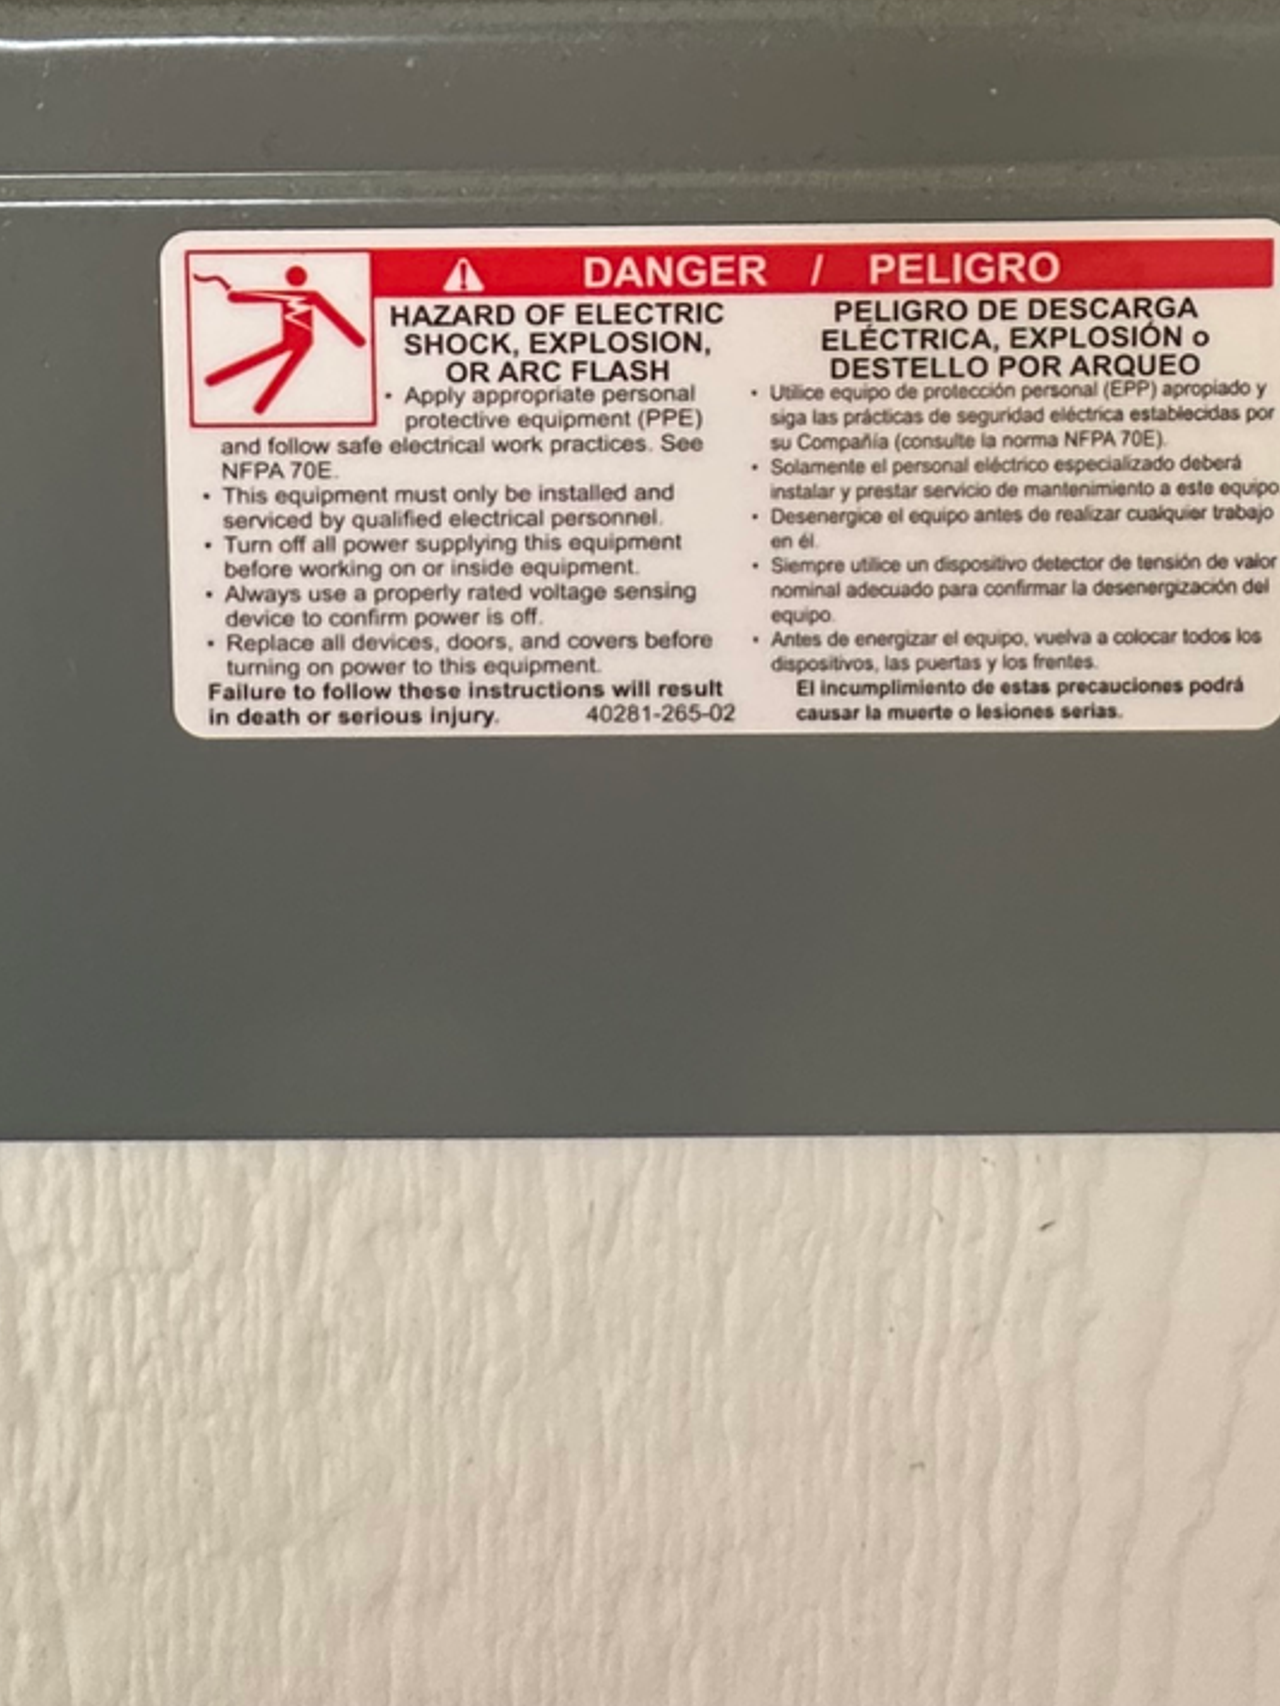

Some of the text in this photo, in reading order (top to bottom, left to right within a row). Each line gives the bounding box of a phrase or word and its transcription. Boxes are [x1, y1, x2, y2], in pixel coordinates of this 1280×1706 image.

[584, 251, 1060, 289] DANGER / PELIGRO
[390, 301, 724, 328] HAZARD OF ELECTRIC
[834, 296, 1199, 326] PELIGRO DE DESCARGA
[404, 330, 711, 358] SHOCK, EXPLOSION,
[821, 320, 1210, 353] ELÉCTRICA, EXPLOSIÓN o
[445, 359, 670, 384] OR ARC FLASH
[830, 353, 1201, 382] DESTELLO POR ARQUEO
[404, 384, 696, 411] Apply appropriate personal
[405, 408, 704, 434] protective equipment (PPE)
[221, 460, 286, 480] NFPA
[585, 702, 736, 724] 40281-265-02
[795, 702, 1122, 722] causar la muerte o lesiones serias.
